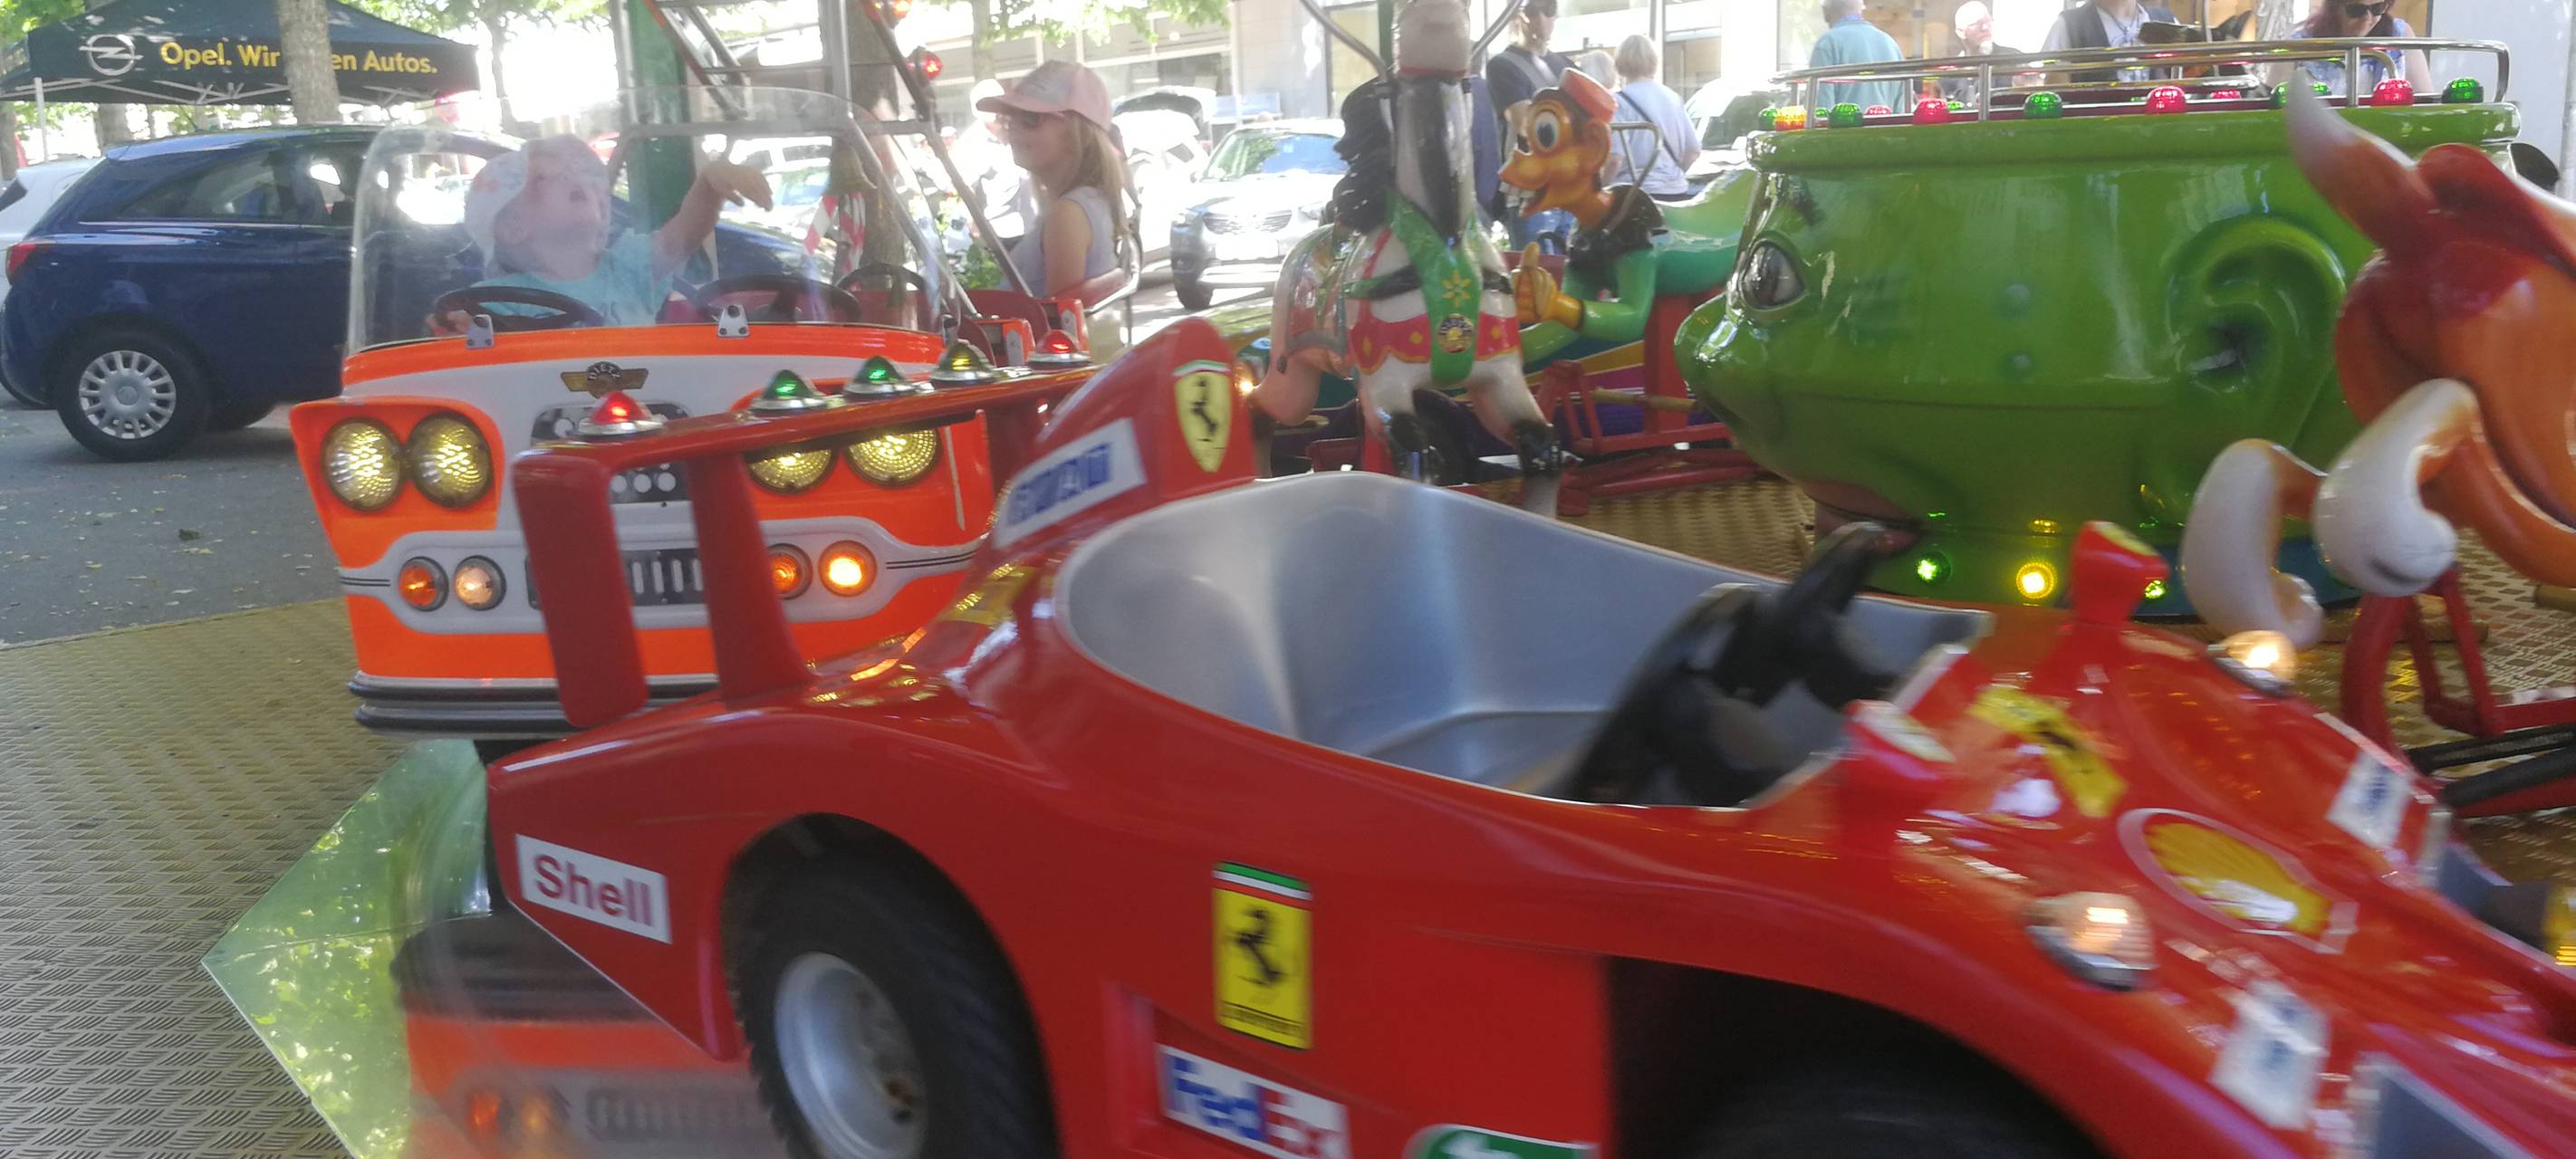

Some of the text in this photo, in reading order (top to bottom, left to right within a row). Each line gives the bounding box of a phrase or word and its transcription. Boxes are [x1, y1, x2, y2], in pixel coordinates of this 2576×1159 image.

[159, 42, 232, 70] Opel.
[237, 43, 281, 67] Wir
[363, 50, 438, 74] Autos.
[533, 853, 654, 928] Shell
[1162, 1052, 1352, 1159] FedEx
